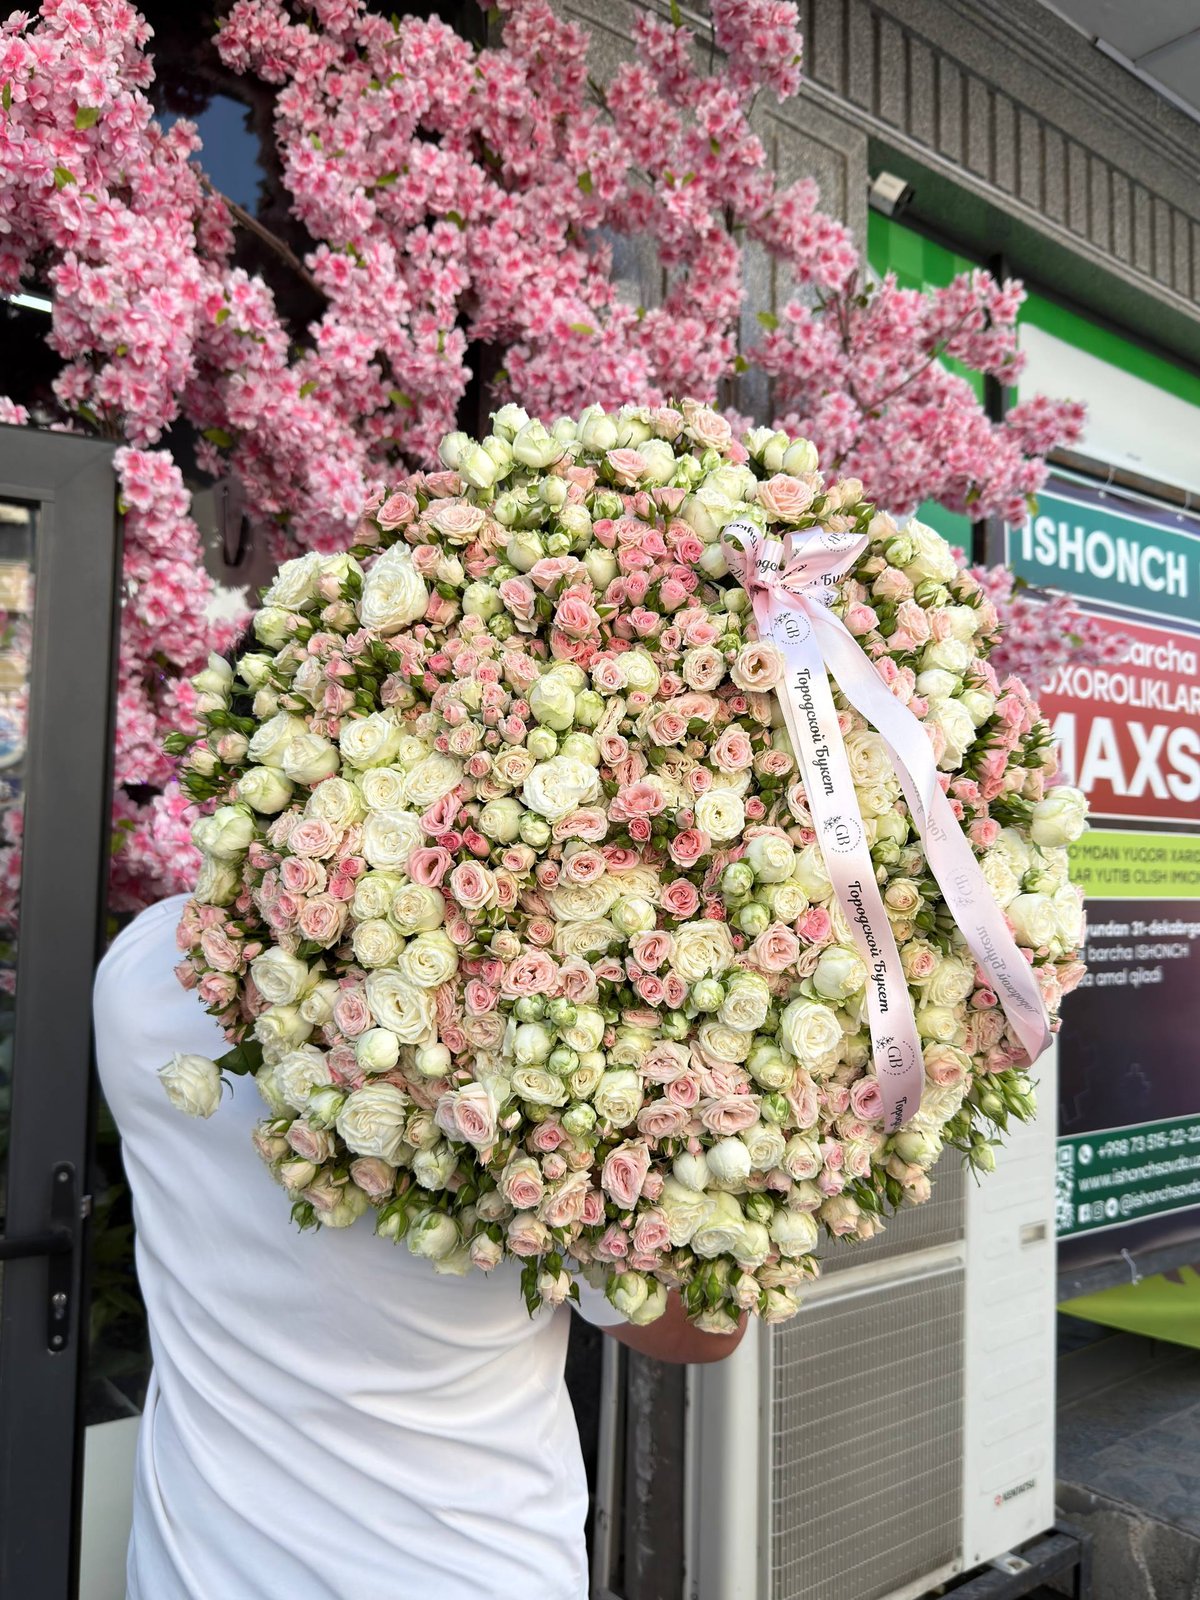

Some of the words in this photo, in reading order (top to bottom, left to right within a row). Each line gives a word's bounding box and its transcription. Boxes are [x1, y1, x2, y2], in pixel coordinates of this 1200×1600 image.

[1022, 513, 1189, 598] ISHONCH
[785, 619, 801, 639] GB
[1121, 640, 1197, 676] archa
[794, 668, 826, 745] Городской
[812, 745, 834, 796] Букет
[835, 824, 851, 846] GB
[847, 880, 882, 958] Городской
[871, 959, 889, 1013] Букет
[887, 1045, 903, 1069] GB
